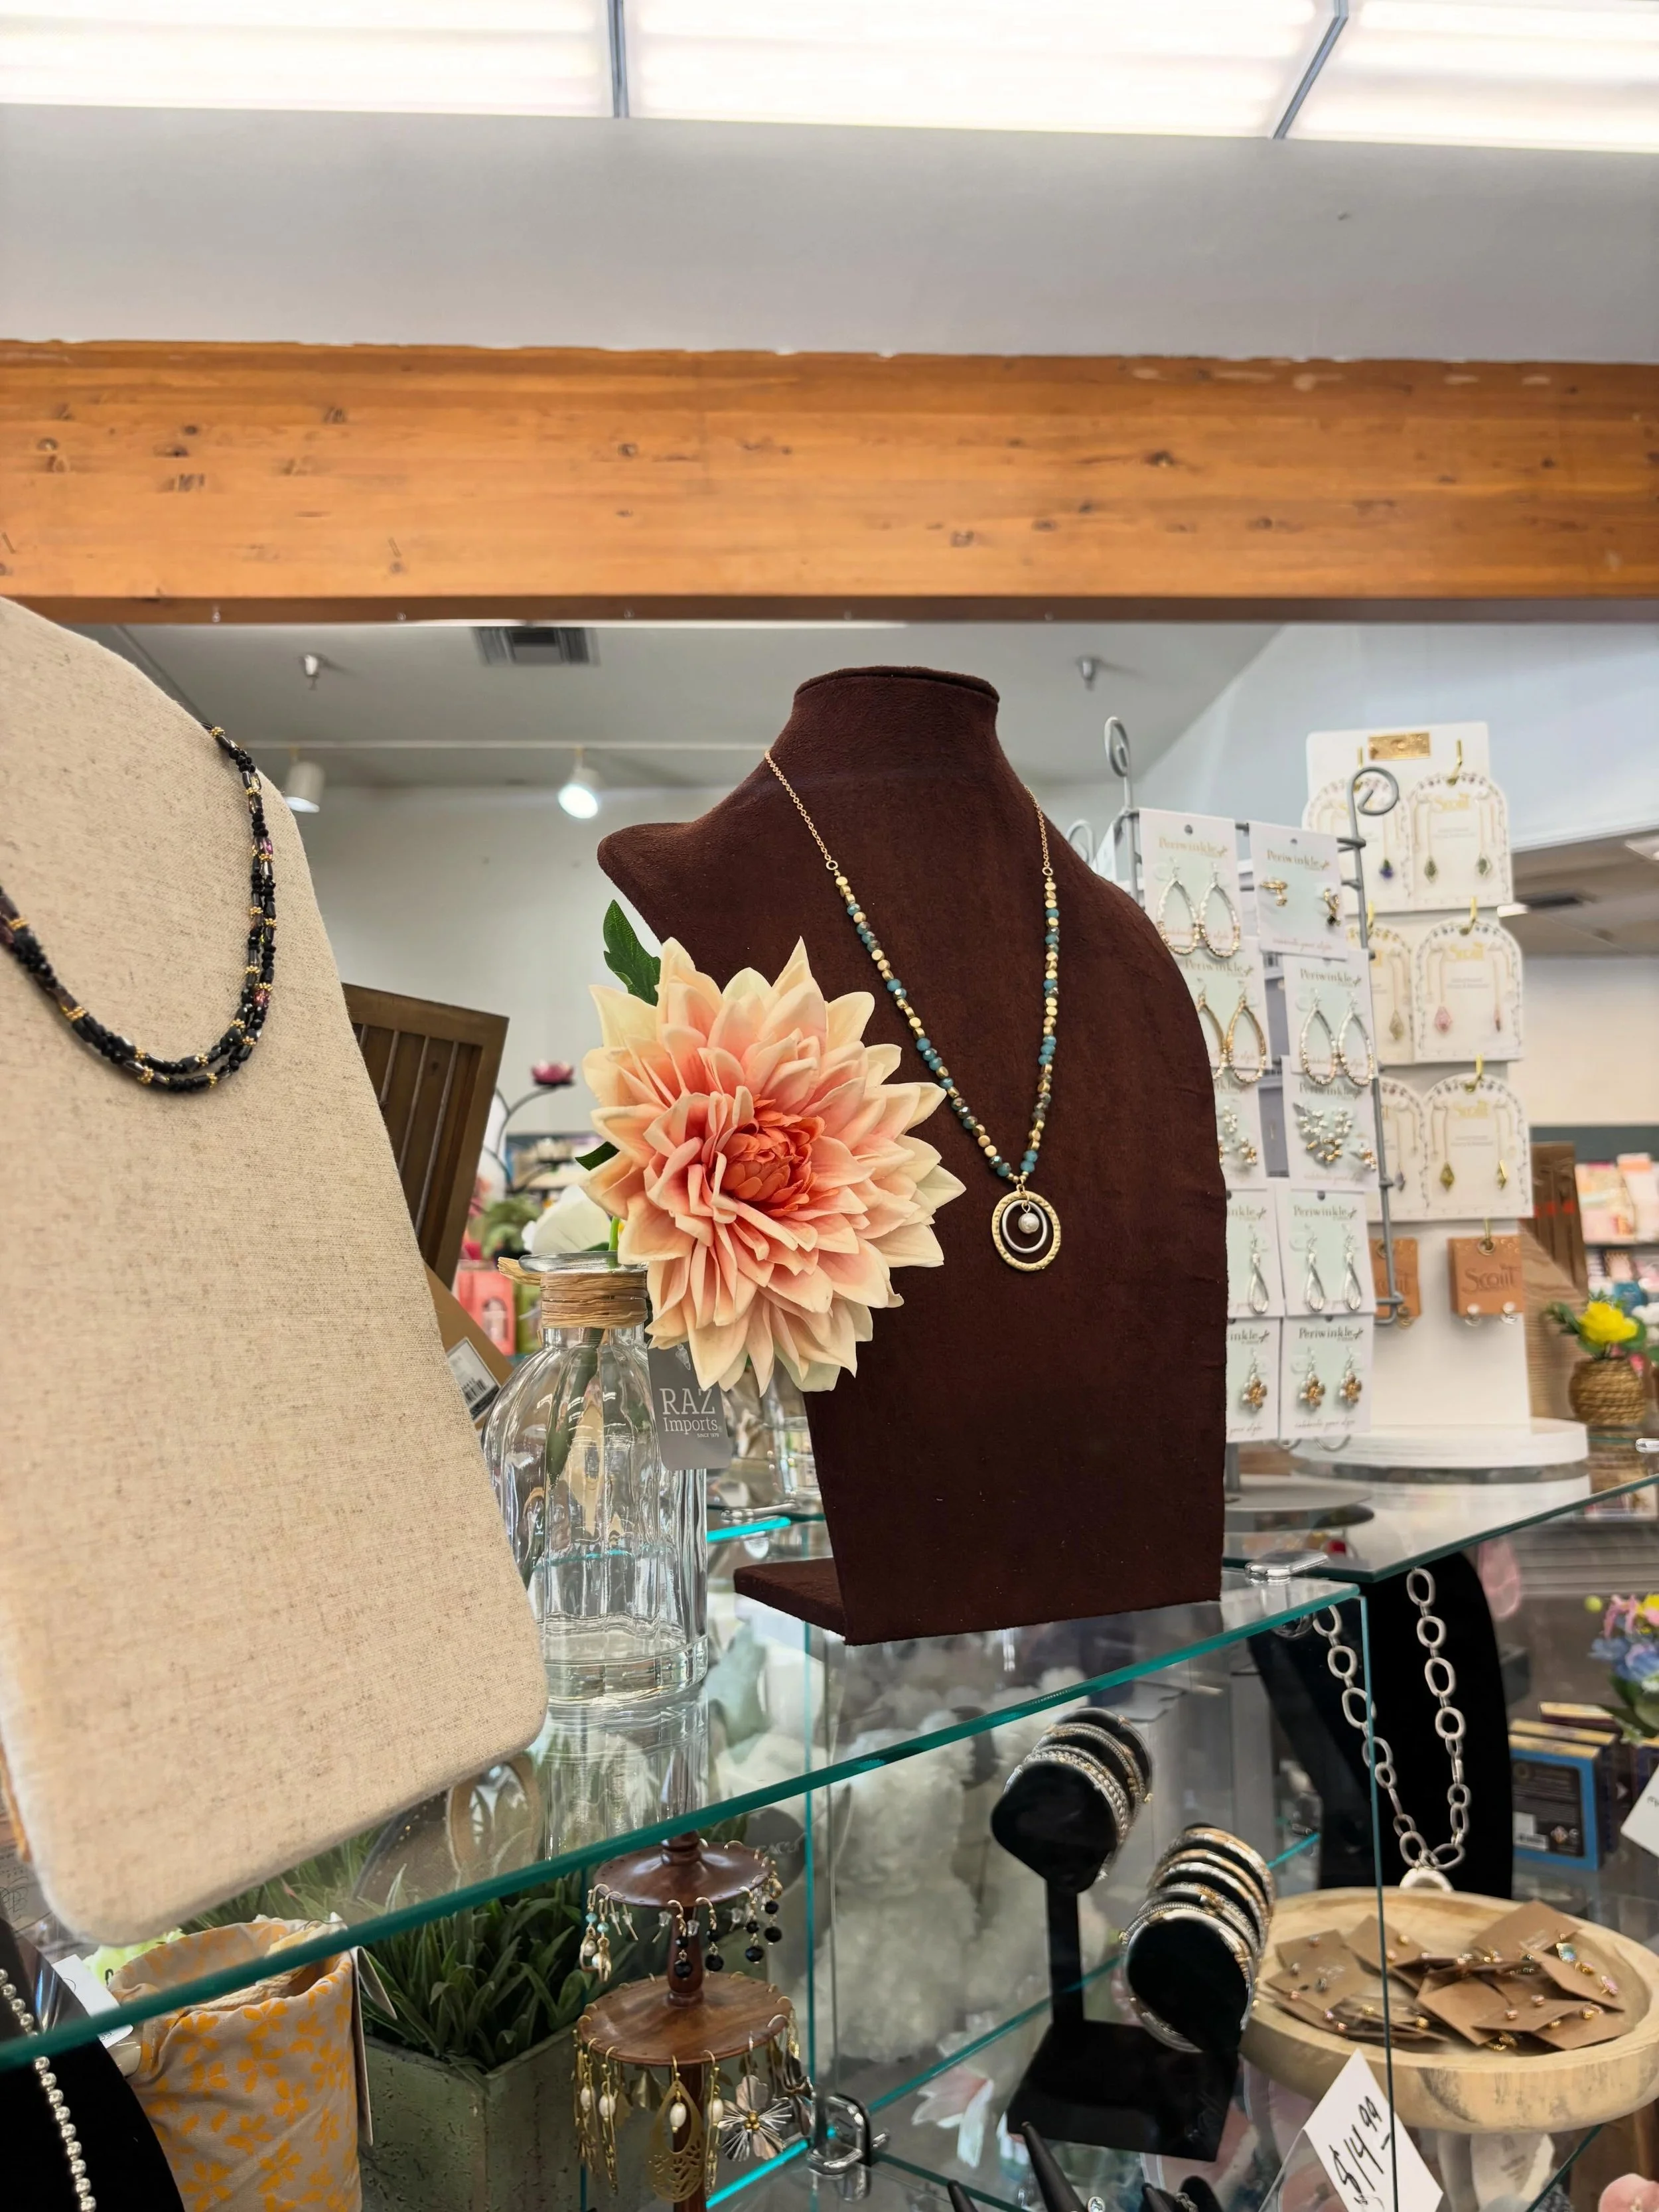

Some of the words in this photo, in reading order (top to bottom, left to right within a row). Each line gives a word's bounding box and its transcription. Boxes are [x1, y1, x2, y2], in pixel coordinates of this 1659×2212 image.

[1267, 849, 1319, 866] Periwinkle
[1301, 968, 1352, 984] Periwinkle
[1294, 1205, 1346, 1217] Periwinkle
[1299, 1327, 1354, 1339] Periwinkle
[660, 1388, 715, 1415] RAZ
[663, 1417, 718, 1435] Imports
